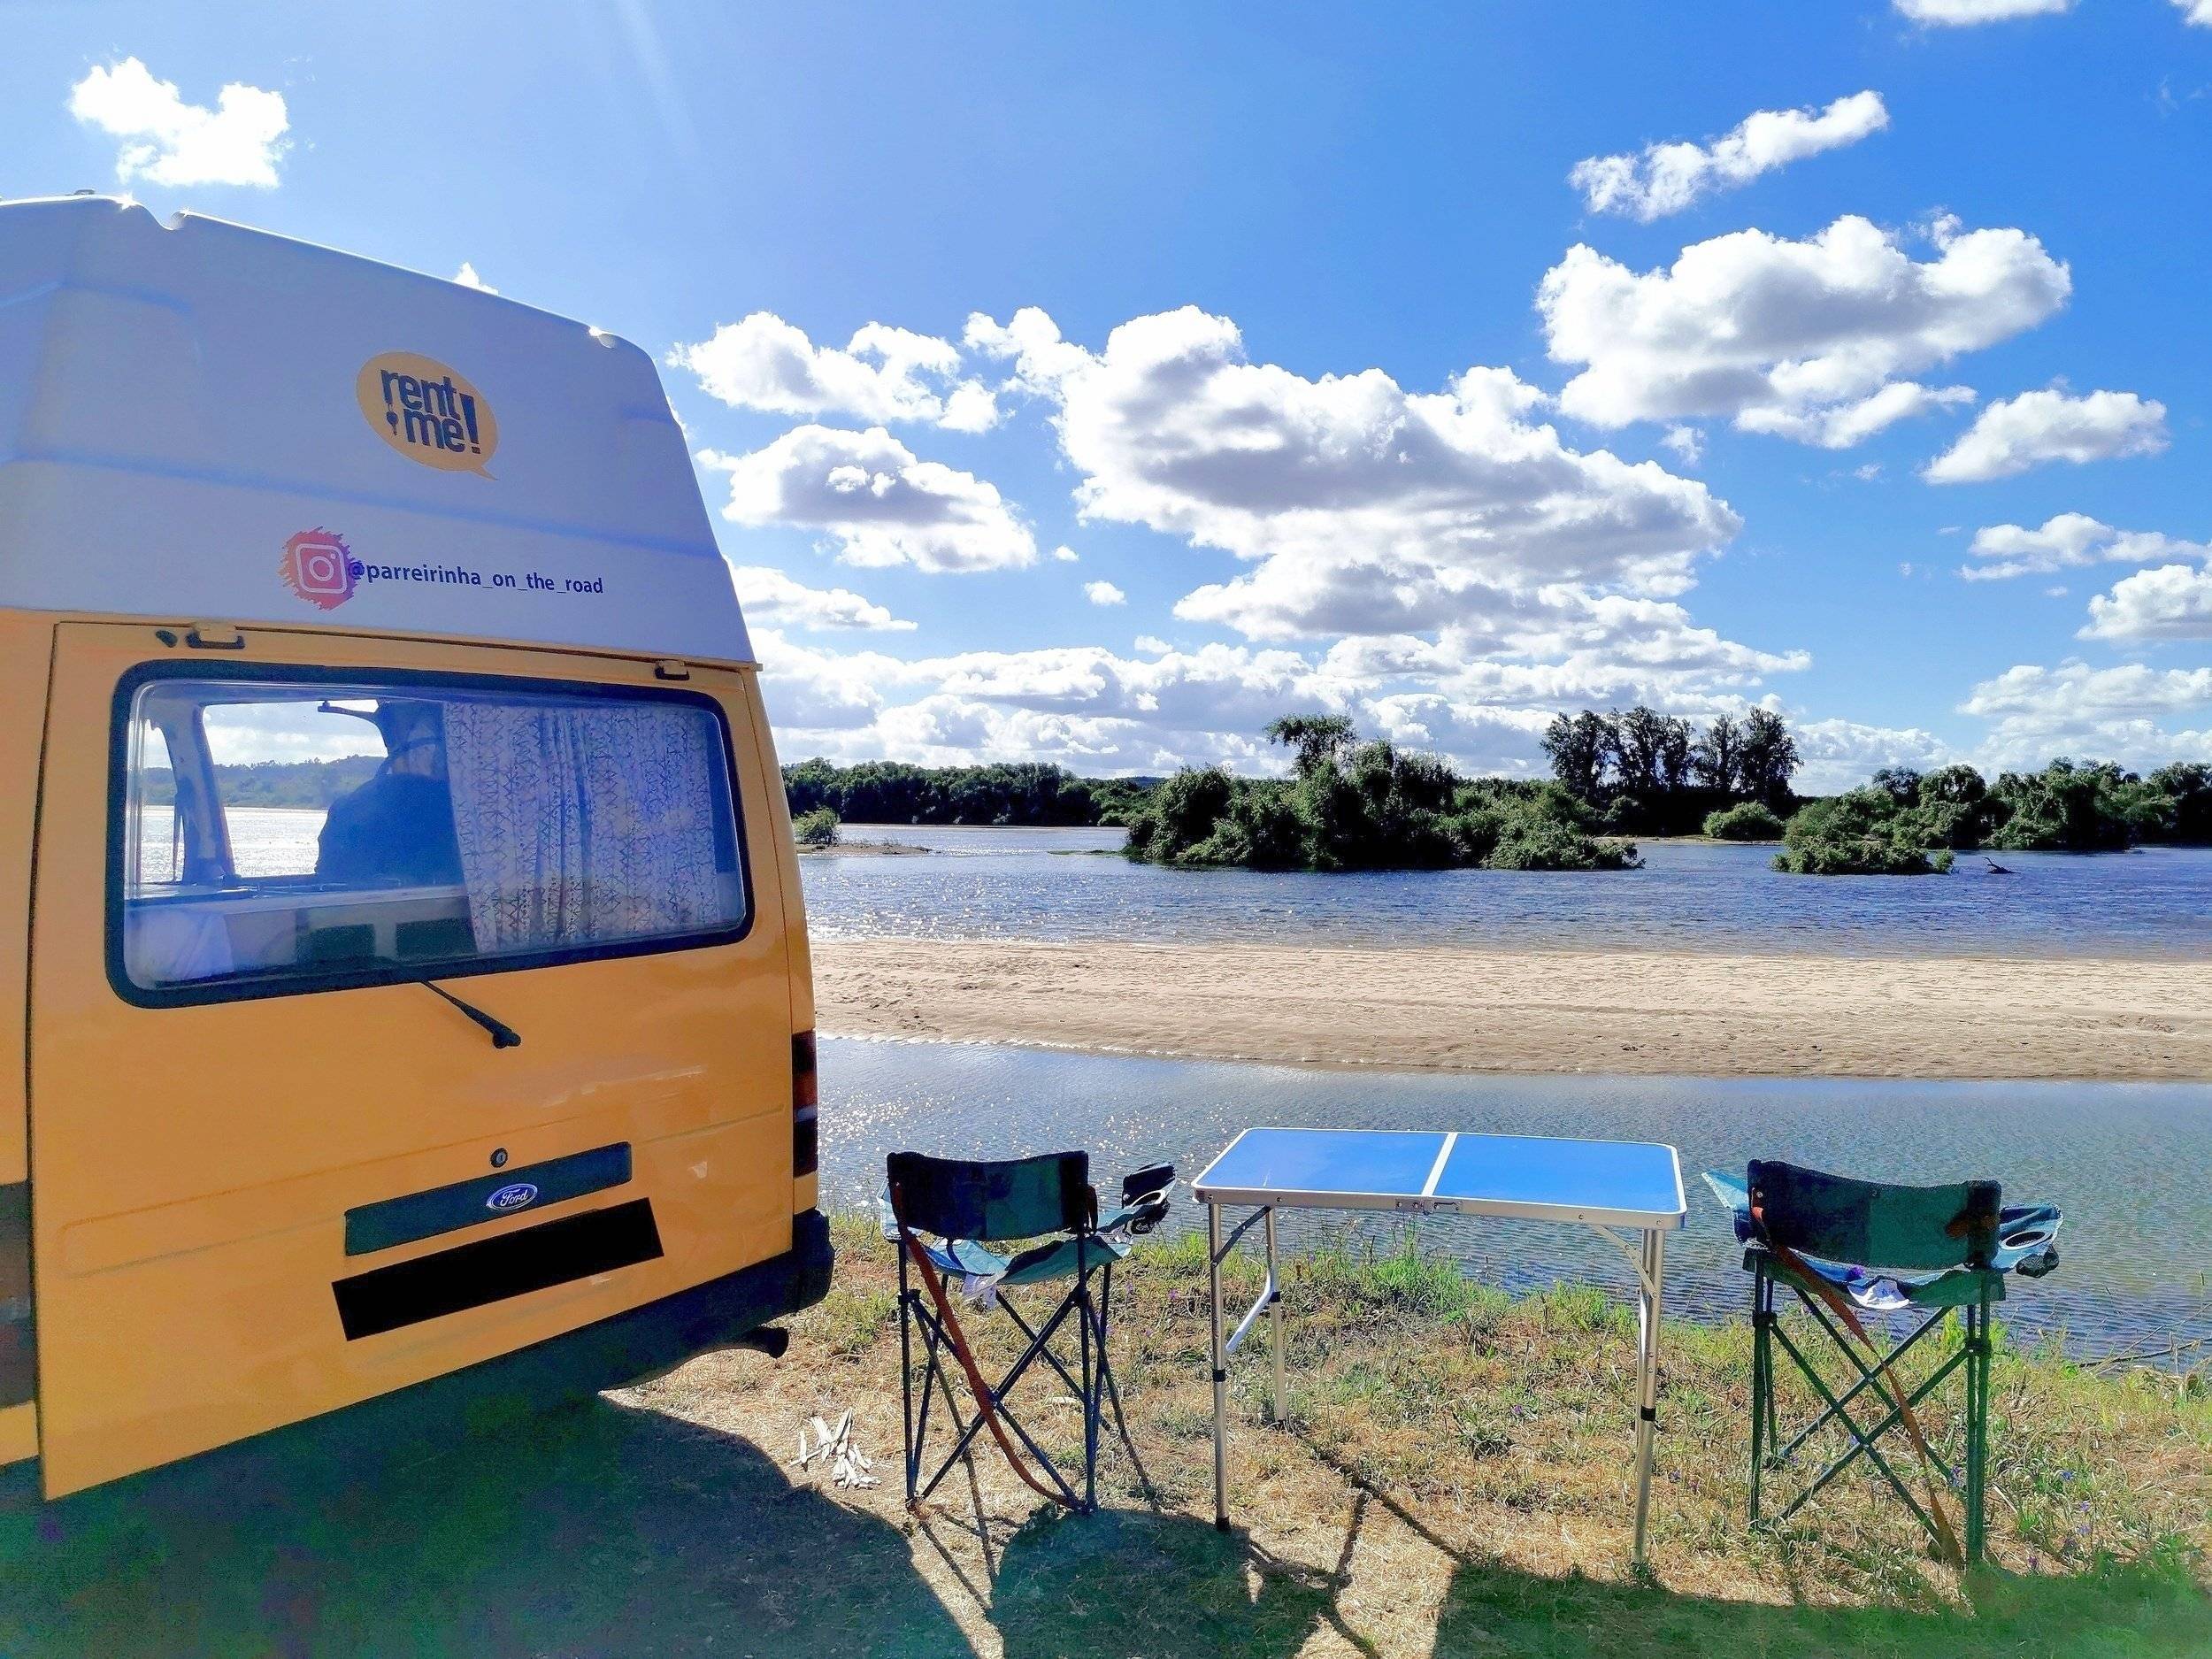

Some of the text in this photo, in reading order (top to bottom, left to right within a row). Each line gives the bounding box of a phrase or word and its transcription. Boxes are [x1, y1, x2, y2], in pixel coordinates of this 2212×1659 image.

[380, 369, 460, 421] rent
[348, 561, 603, 594] @parreirinha_on_the_road
[500, 1188, 528, 1207] Ford
